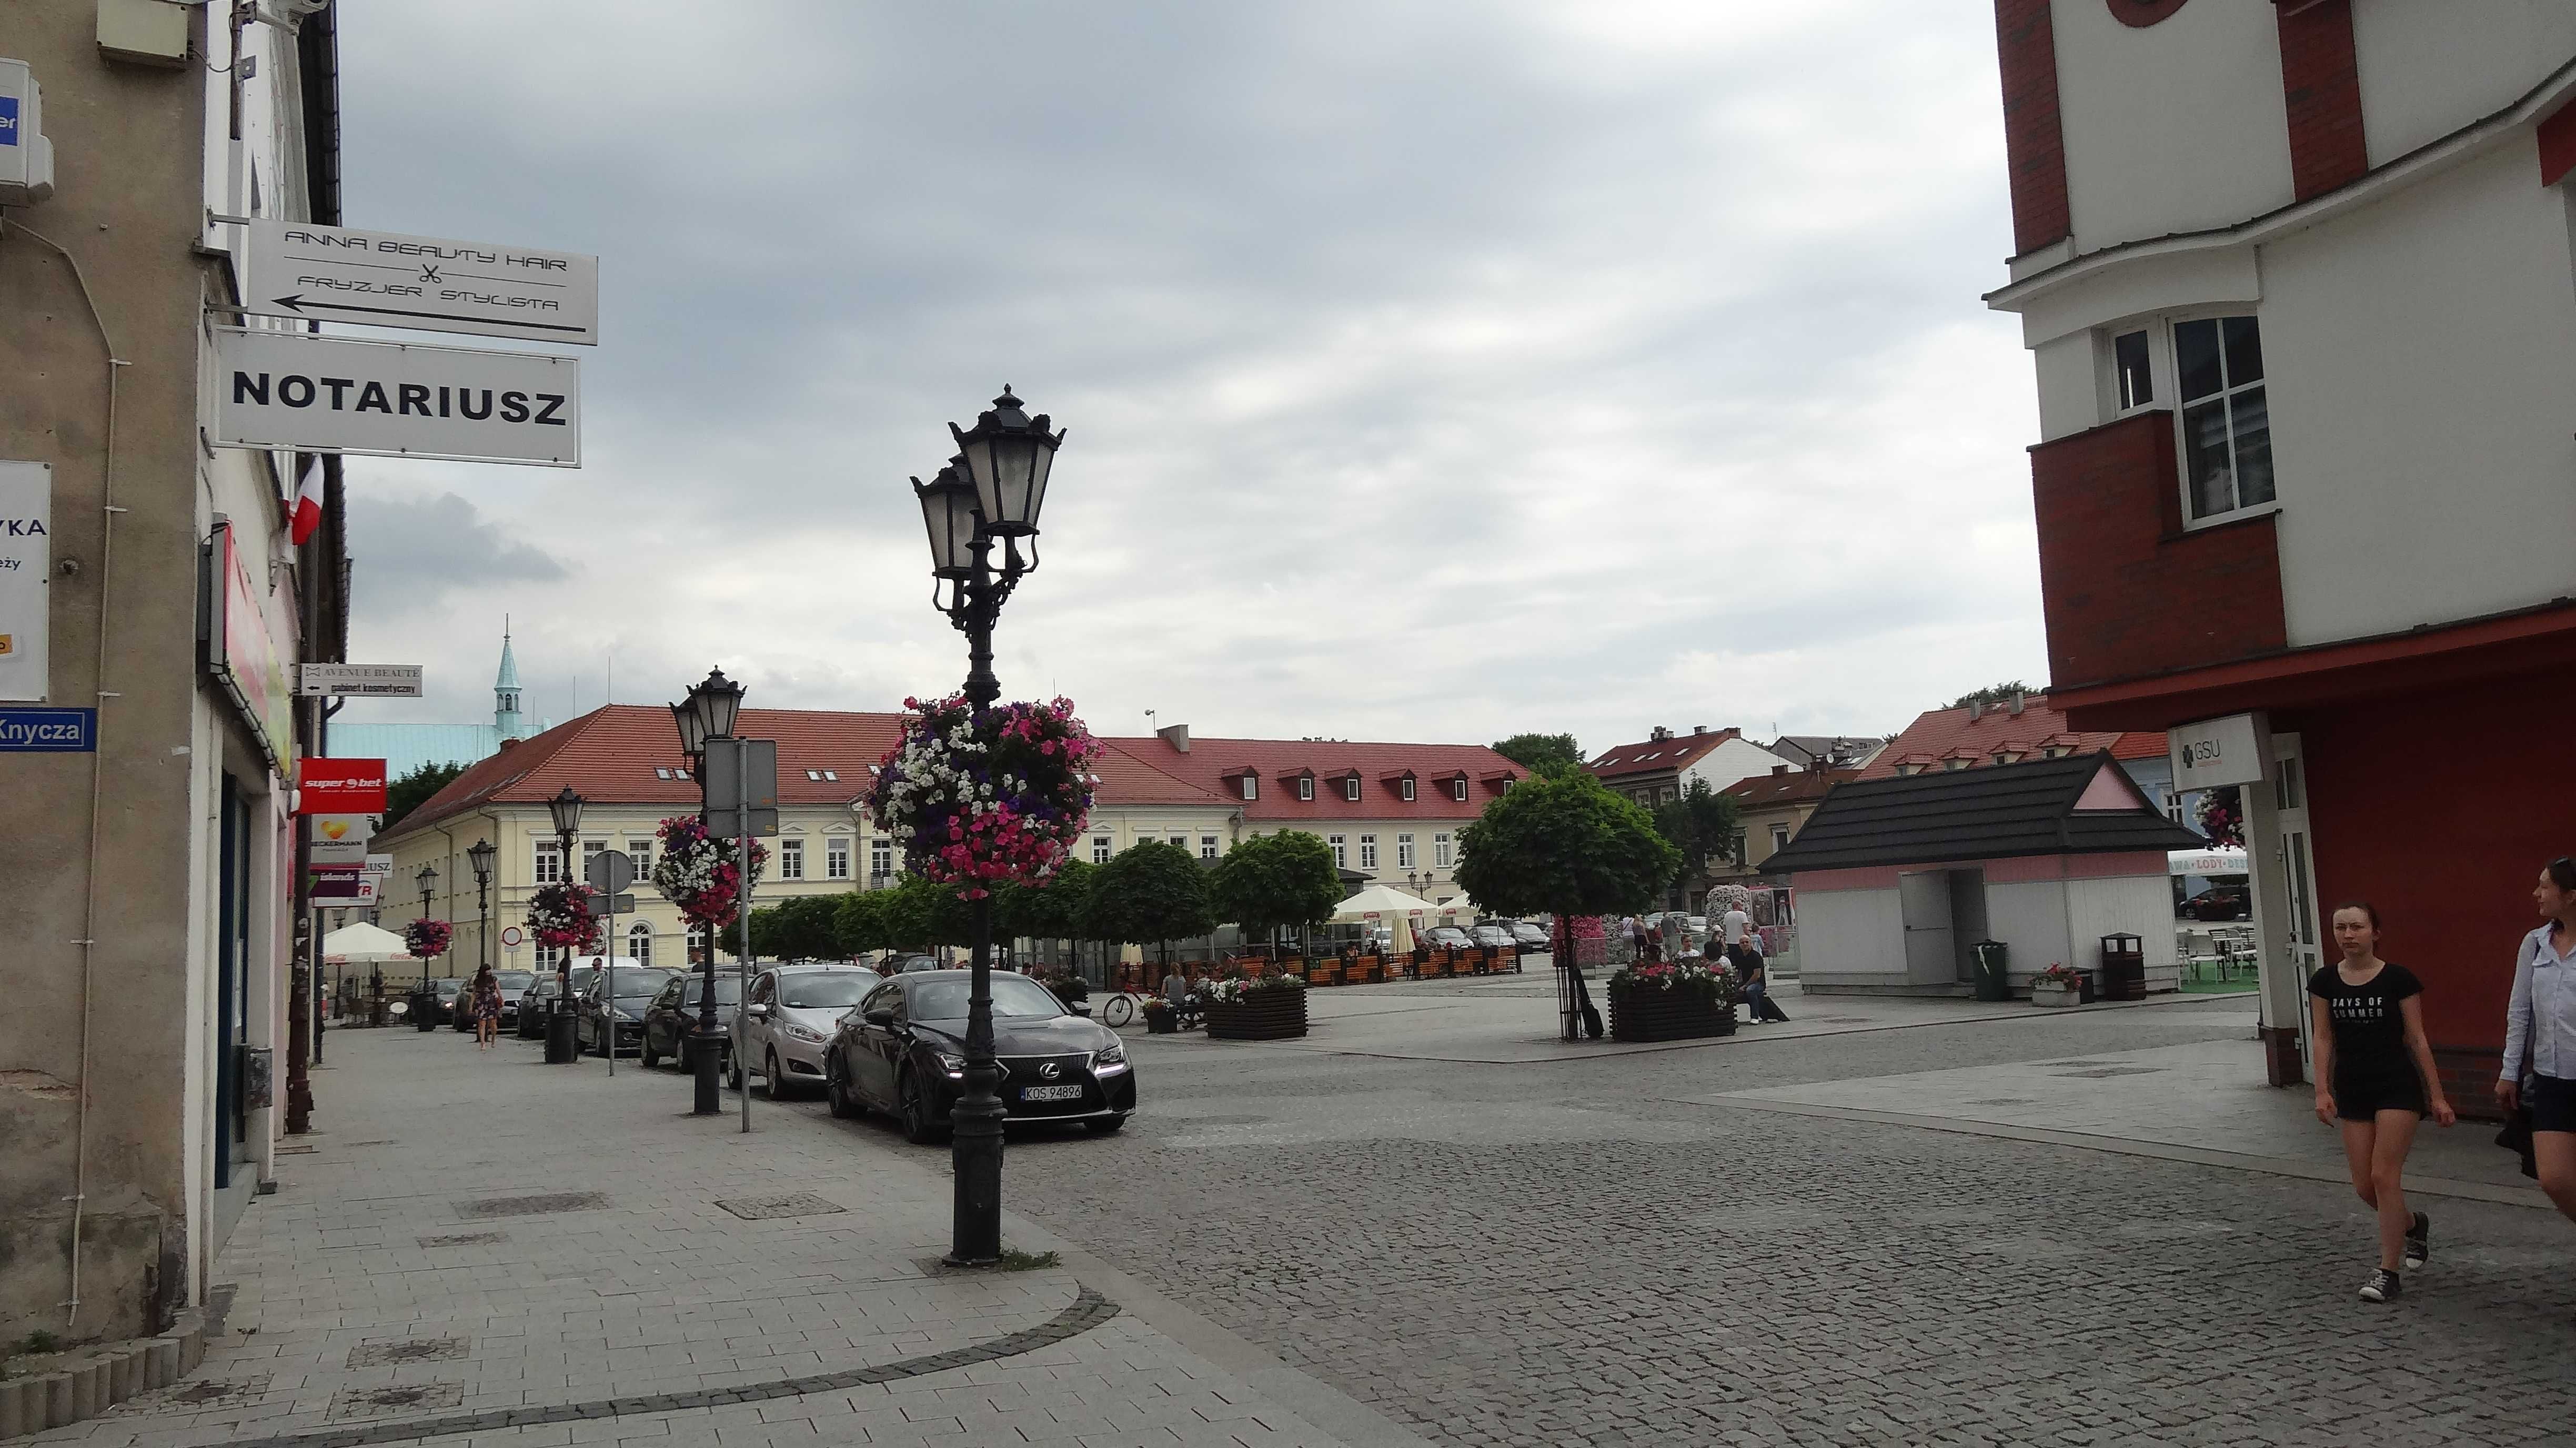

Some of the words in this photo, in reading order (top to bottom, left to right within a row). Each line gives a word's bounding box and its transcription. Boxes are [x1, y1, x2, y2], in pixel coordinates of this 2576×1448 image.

[285, 231, 368, 250] ANNA
[378, 241, 496, 263] BEAUTY
[507, 255, 567, 271] HAIR
[298, 276, 422, 297] FRYZJER
[440, 290, 559, 311] STYLISTA
[234, 371, 567, 426] NOTARIUSZ
[331, 683, 361, 693] gabinet
[364, 683, 416, 694] kosmetyczny
[2195, 739, 2220, 760] GSU
[2196, 859, 2223, 869] LODY
[2368, 997, 2383, 1005] OF
[1027, 1088, 1046, 1099] KOS
[1050, 1085, 1081, 1098] 94896
